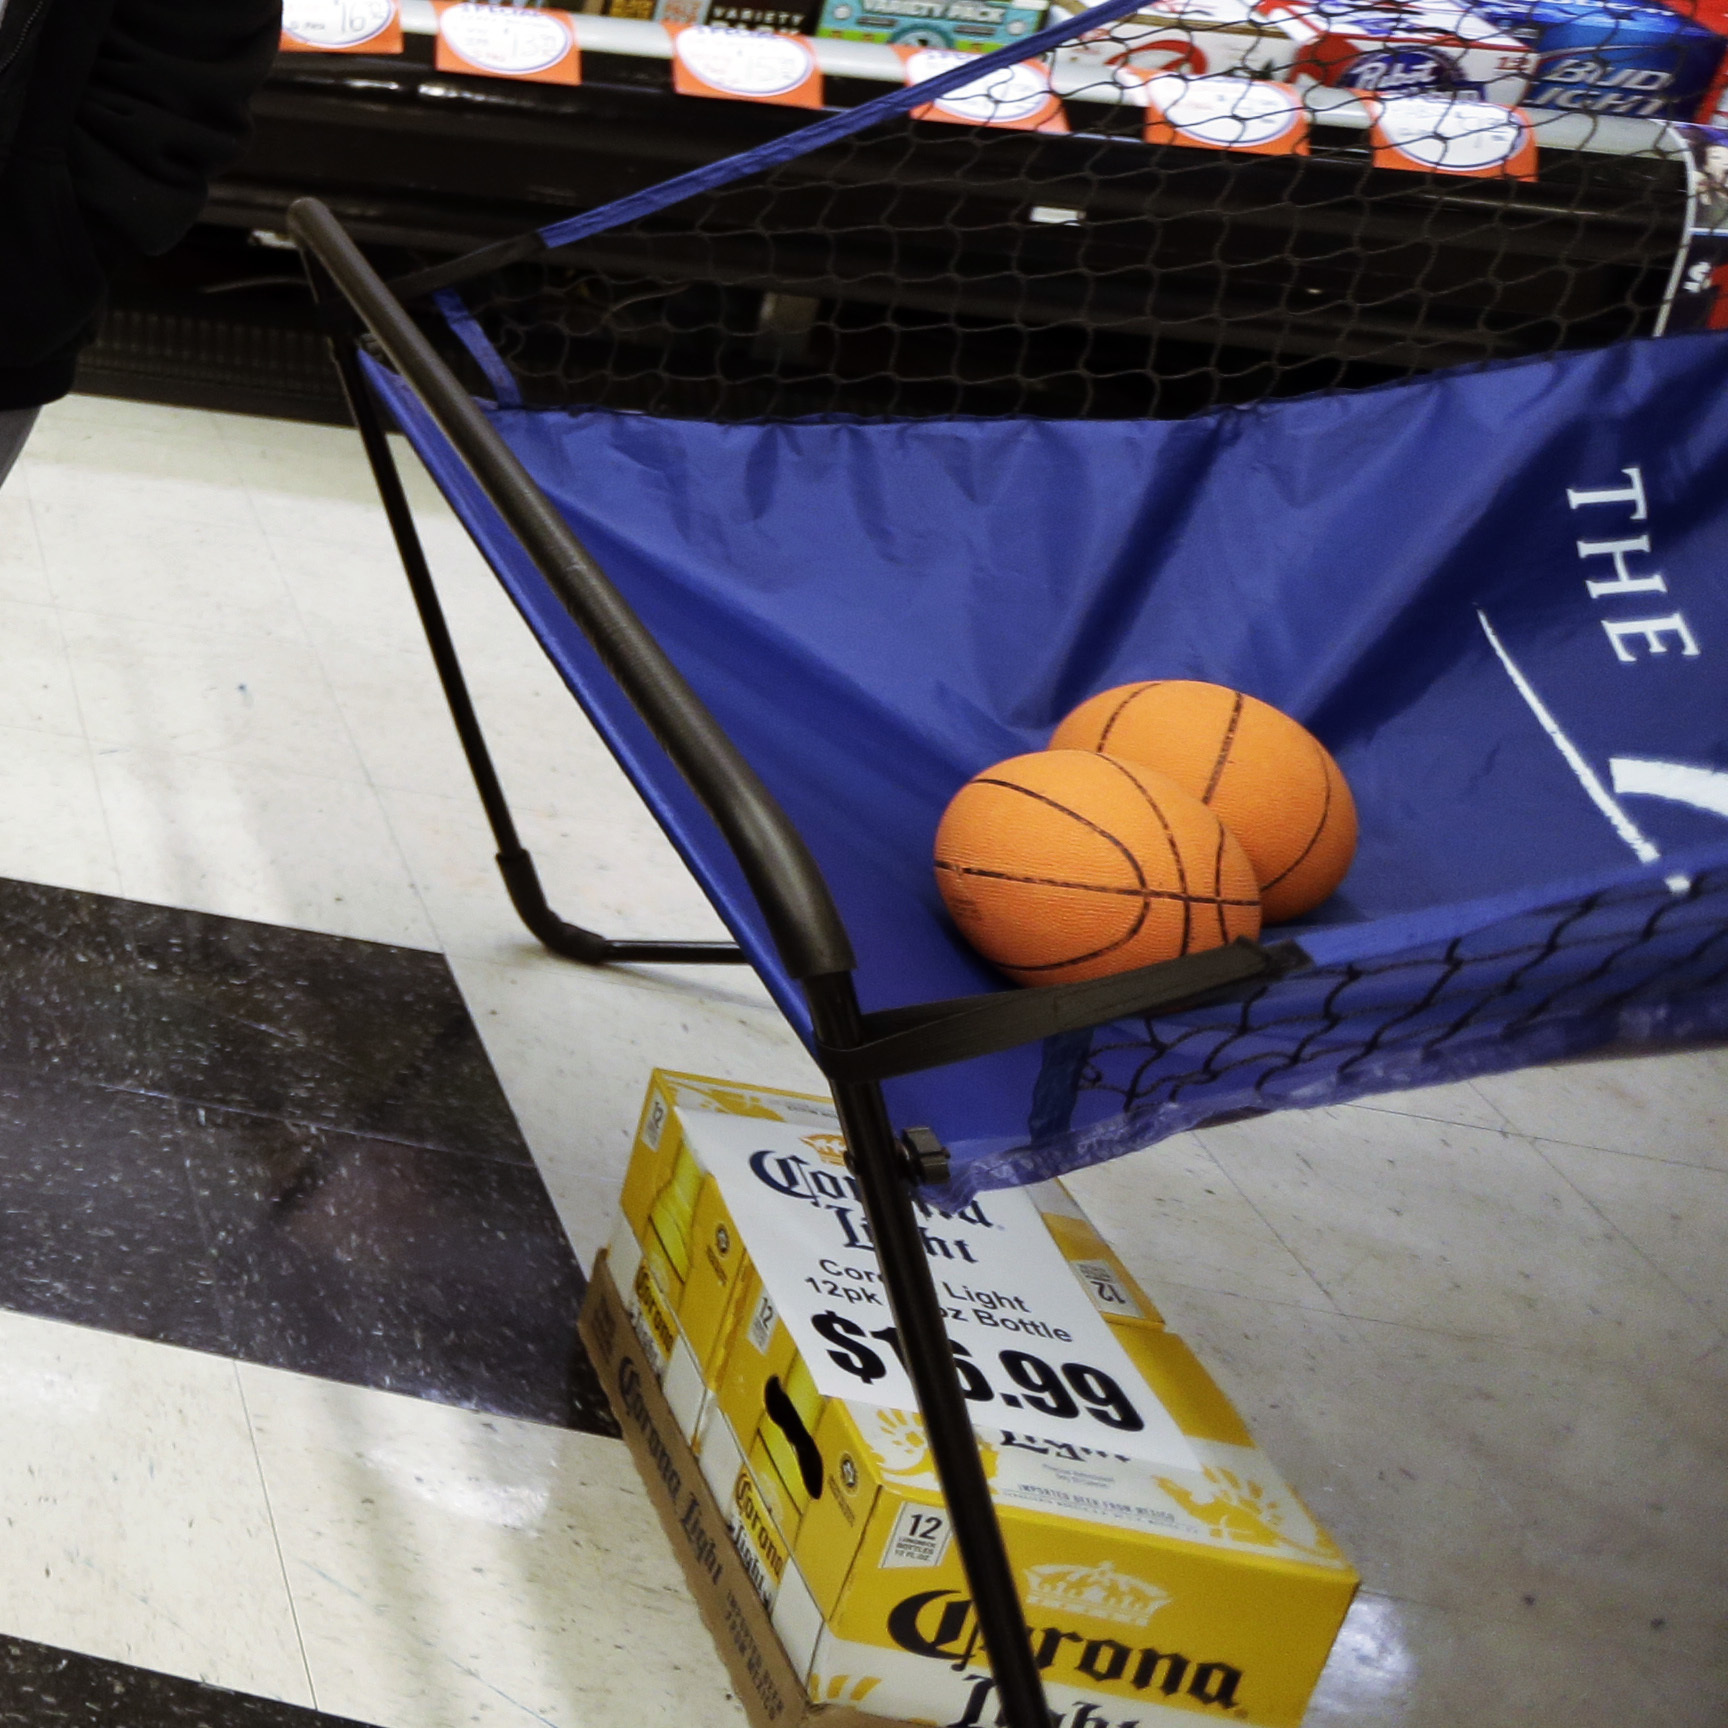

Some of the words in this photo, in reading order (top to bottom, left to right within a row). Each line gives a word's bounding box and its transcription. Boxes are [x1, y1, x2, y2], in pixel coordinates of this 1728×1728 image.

[712, 5, 804, 27] VARIETY
[1355, 58, 1438, 91] Pabst
[1547, 58, 1672, 91] BUD
[1565, 466, 1702, 664] THE
[758, 1294, 775, 1326] 12
[805, 1275, 884, 1306] 12pk
[975, 1308, 1074, 1343] Bottle
[942, 1280, 1031, 1315] Light
[1092, 1280, 1128, 1306] 12
[618, 1354, 681, 1505] Corona
[680, 1491, 725, 1586] Light
[734, 1469, 784, 1584] Corona
[907, 1513, 945, 1542] 12
[887, 1588, 1245, 1710] Crona
